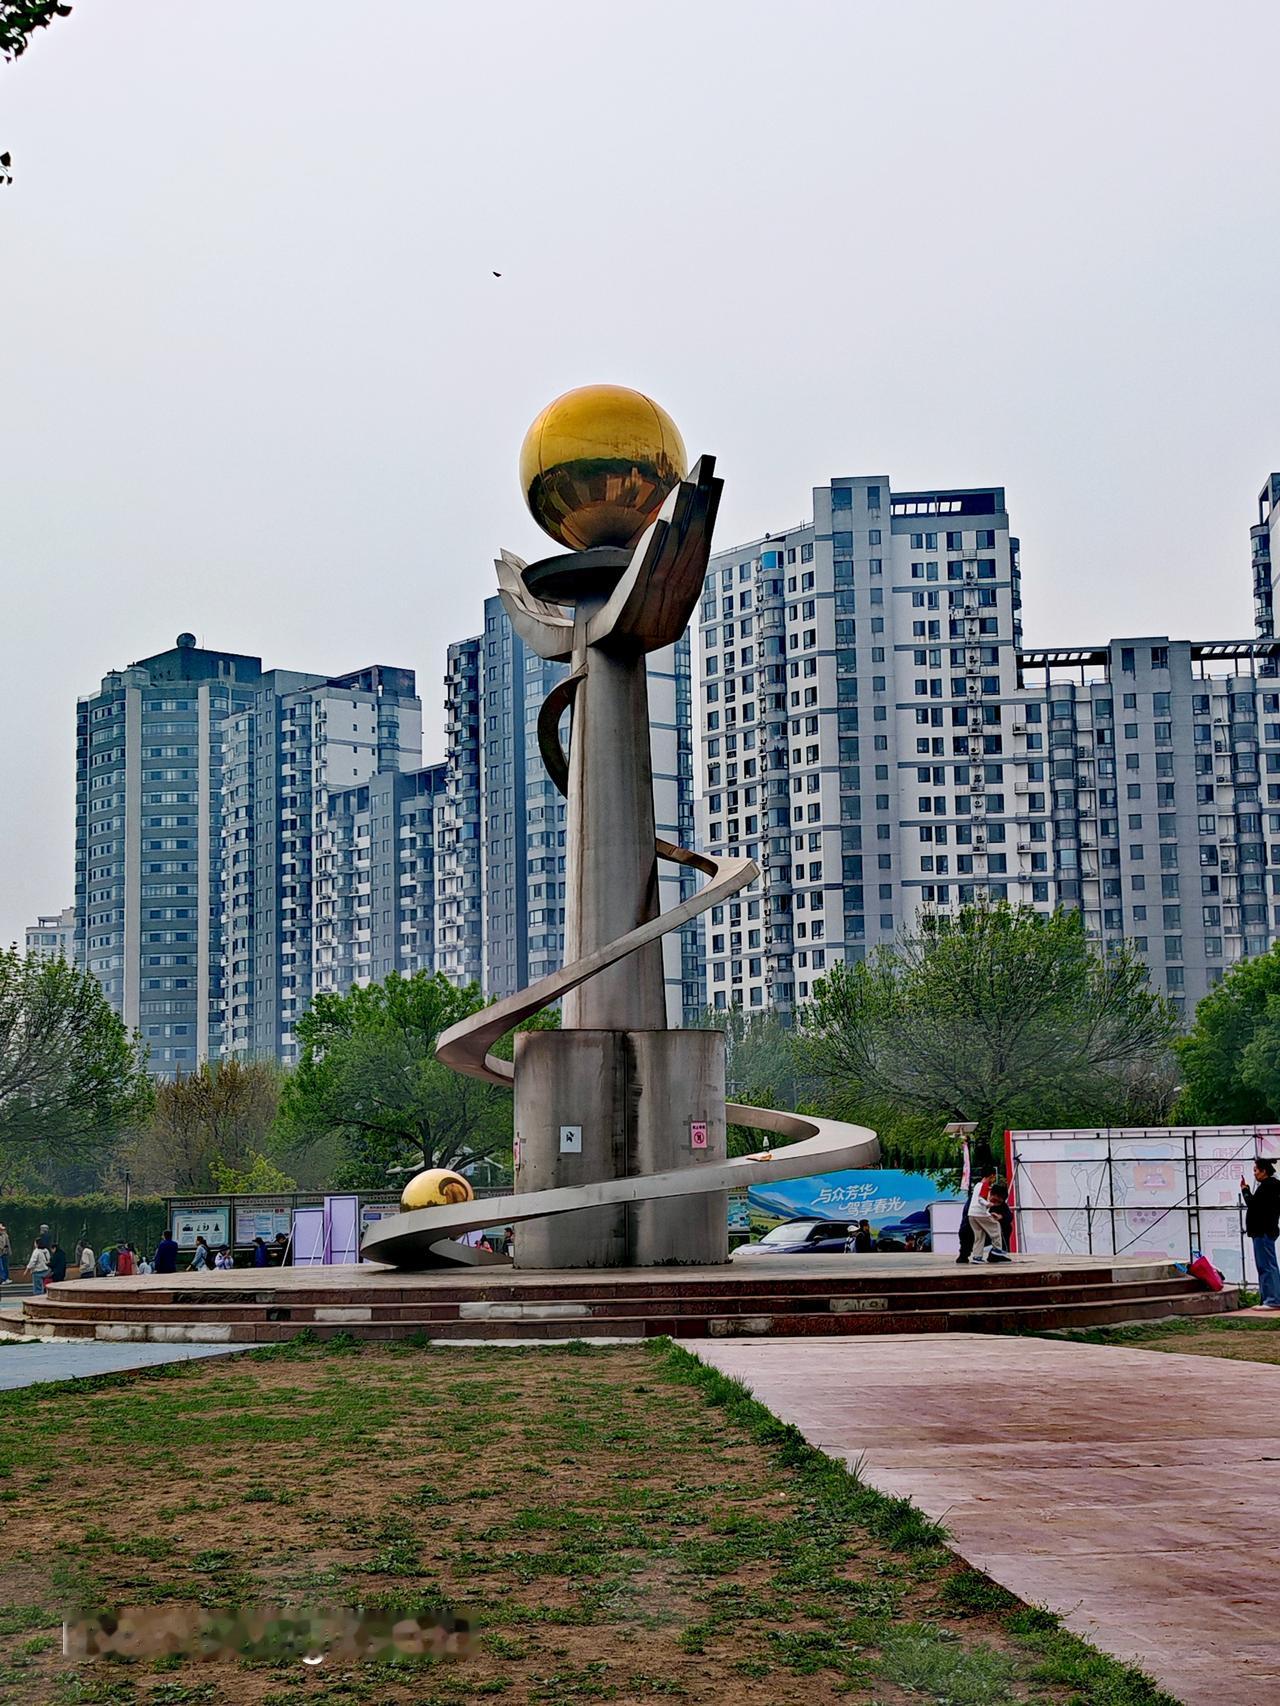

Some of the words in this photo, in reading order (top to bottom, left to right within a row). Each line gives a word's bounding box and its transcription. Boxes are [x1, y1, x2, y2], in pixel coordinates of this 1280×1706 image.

[811, 1183, 878, 1206] 与众芳华
[838, 1196, 906, 1216] 驾享春光
